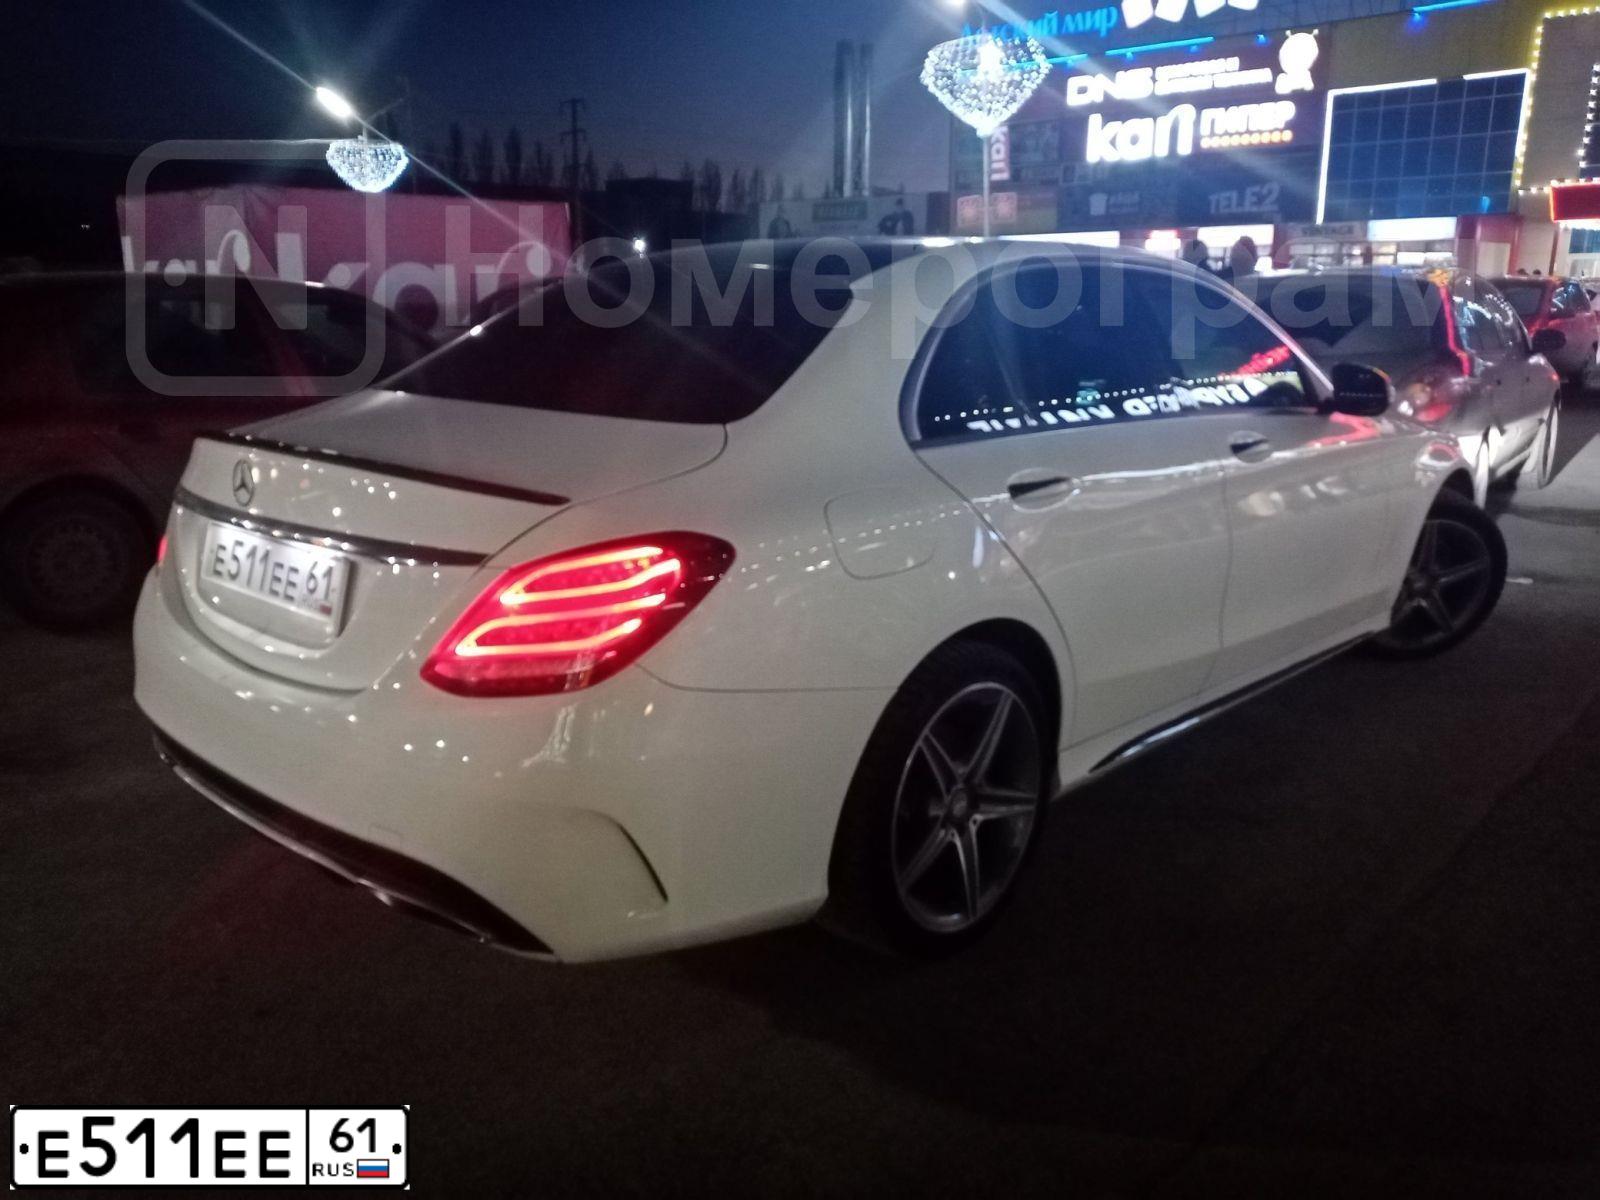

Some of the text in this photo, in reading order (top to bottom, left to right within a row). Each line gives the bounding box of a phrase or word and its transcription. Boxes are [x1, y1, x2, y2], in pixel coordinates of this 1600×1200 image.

[1062, 6, 1118, 38] мир
[1208, 181, 1281, 214] TELE2
[212, 540, 334, 601] E511EE 61
